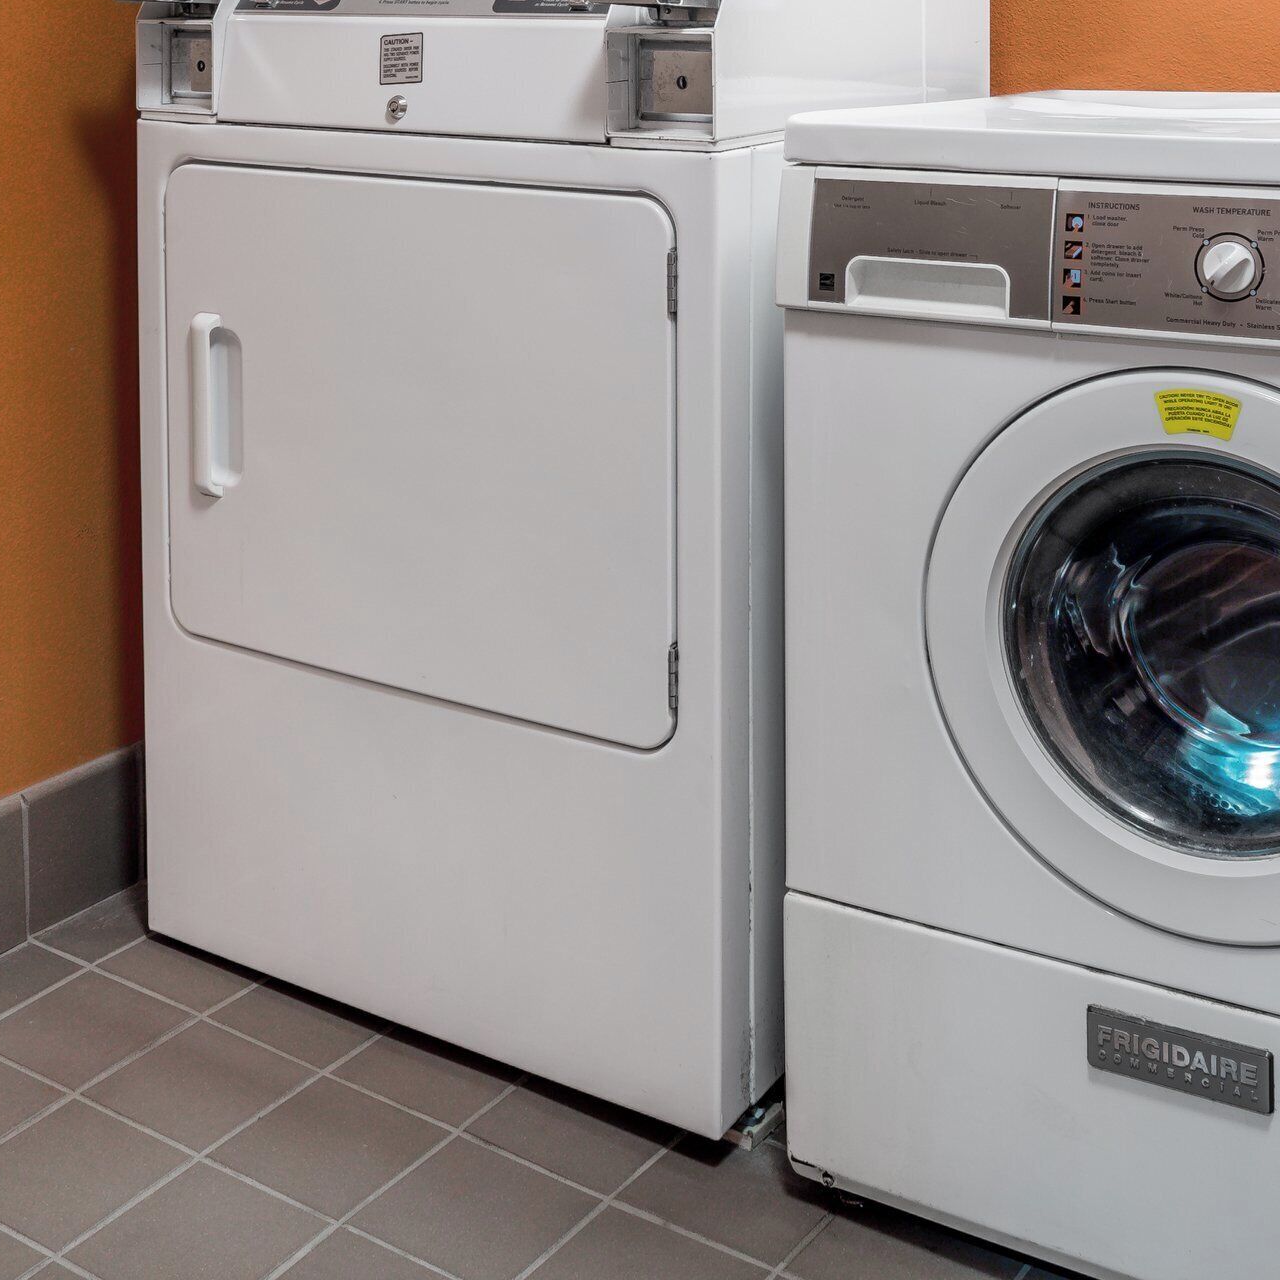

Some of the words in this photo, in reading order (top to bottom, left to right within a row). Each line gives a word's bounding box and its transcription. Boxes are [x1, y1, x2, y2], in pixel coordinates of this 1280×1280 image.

[1088, 202, 1140, 210] INSTRUCTIONS
[1192, 206, 1214, 214] WASH
[1217, 207, 1271, 216] TEMPERATURE
[1166, 316, 1201, 325] Commercial
[1203, 319, 1221, 327] Heavy
[1247, 323, 1275, 331] Stainless
[1097, 1024, 1258, 1087] FRIGIDAIRE
[1098, 1049, 1258, 1102] COMMERCIAL
